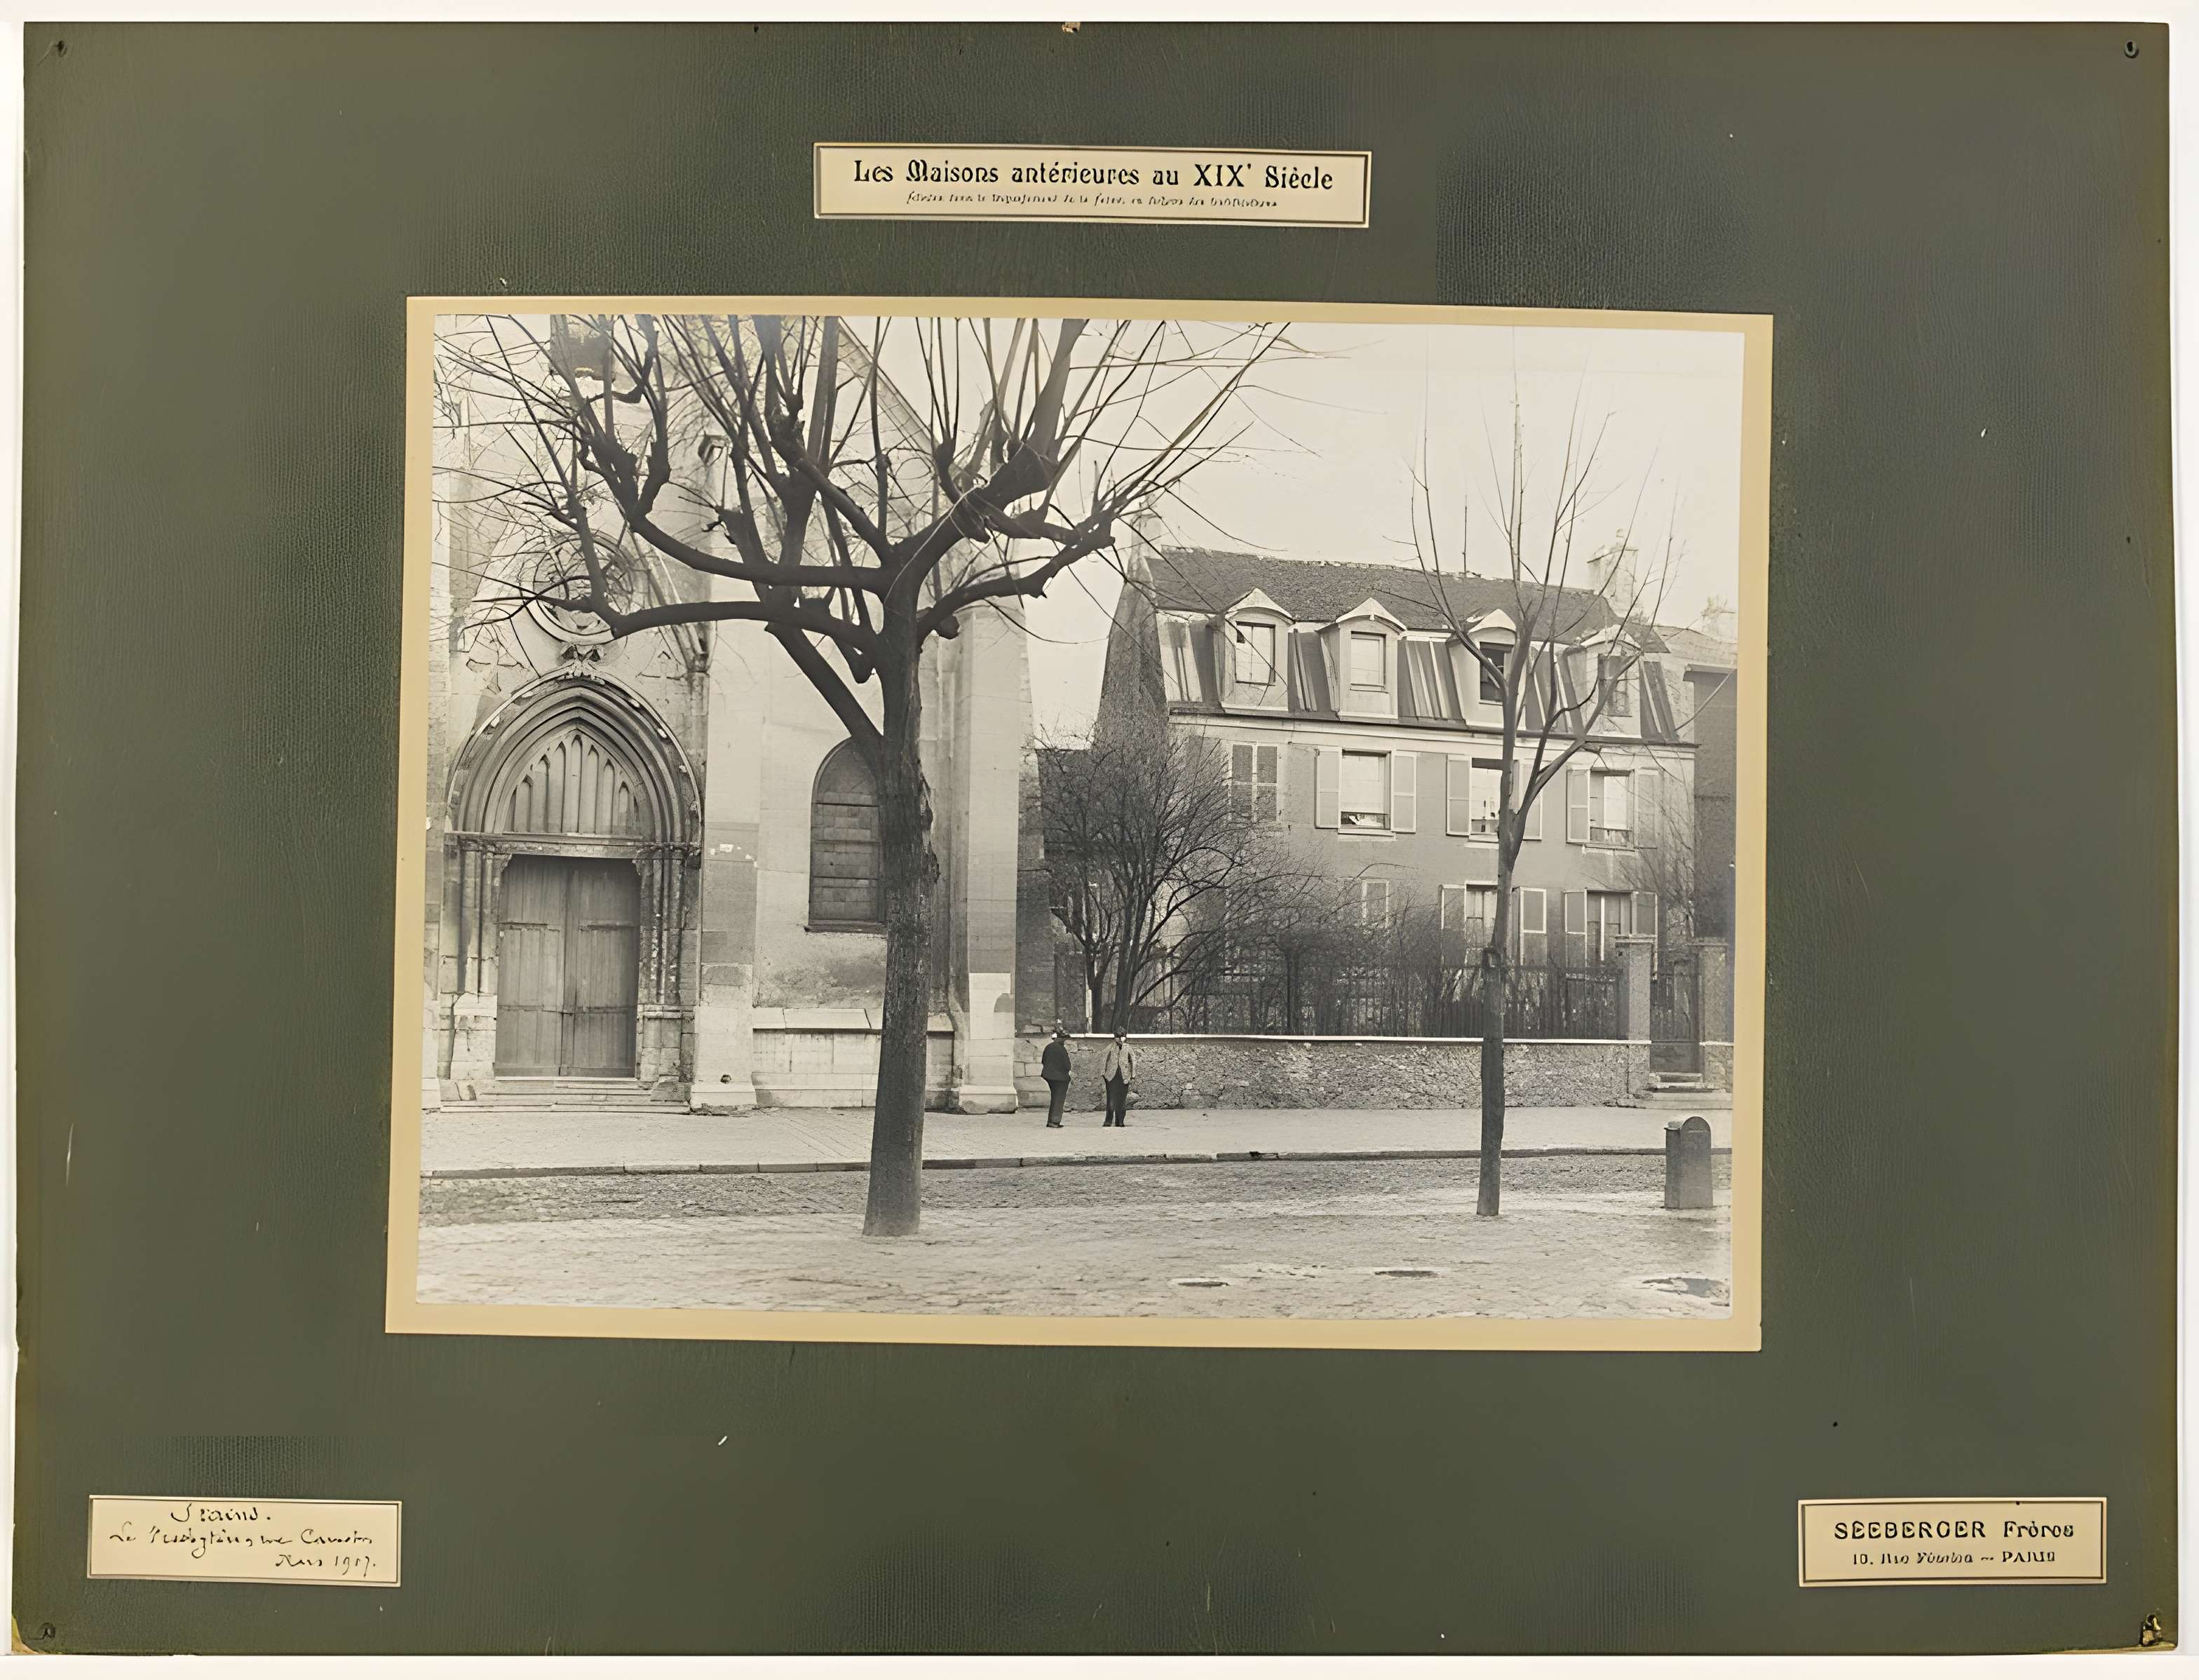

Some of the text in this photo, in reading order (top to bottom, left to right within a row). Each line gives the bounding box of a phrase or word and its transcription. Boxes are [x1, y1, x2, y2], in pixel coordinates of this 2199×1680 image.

[853, 160, 894, 183] Les
[906, 159, 999, 183] Maisons
[1011, 161, 1139, 185] antérieures
[1152, 170, 1179, 186] au
[1264, 165, 1333, 190] Siècle
